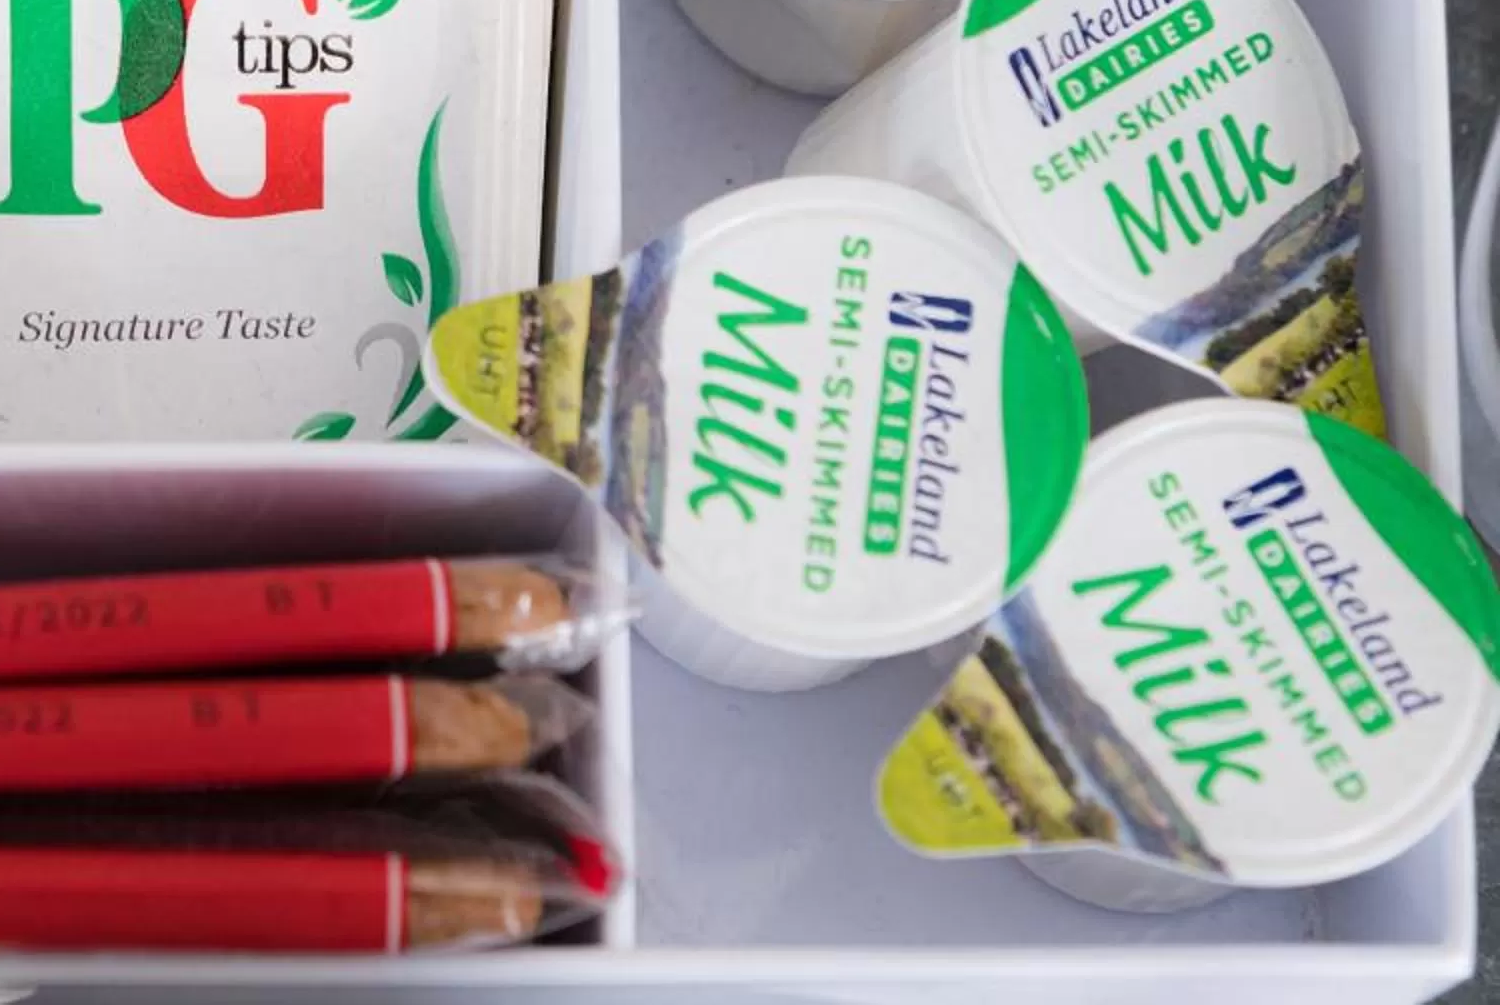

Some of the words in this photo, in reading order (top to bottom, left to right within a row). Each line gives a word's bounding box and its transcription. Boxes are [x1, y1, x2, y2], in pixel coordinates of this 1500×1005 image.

[231, 19, 356, 90] tips
[1030, 30, 1277, 195] SEMI-SKIMMED
[1063, 7, 1204, 106] DAIRIES
[1102, 112, 1298, 277] Milk
[17, 308, 205, 353] Signature
[214, 308, 317, 342] Taste
[477, 324, 508, 398] UHT
[687, 270, 809, 526] Milk
[803, 234, 871, 594] SEMI-SKIMMED
[867, 349, 917, 550] DAIRIES
[909, 341, 970, 566] Lakeland
[1072, 564, 1269, 804] Milk
[1149, 470, 1369, 803] SEMI-SKIMMED
[1254, 543, 1391, 733] DAIRIES
[1285, 508, 1445, 717] Lakeland
